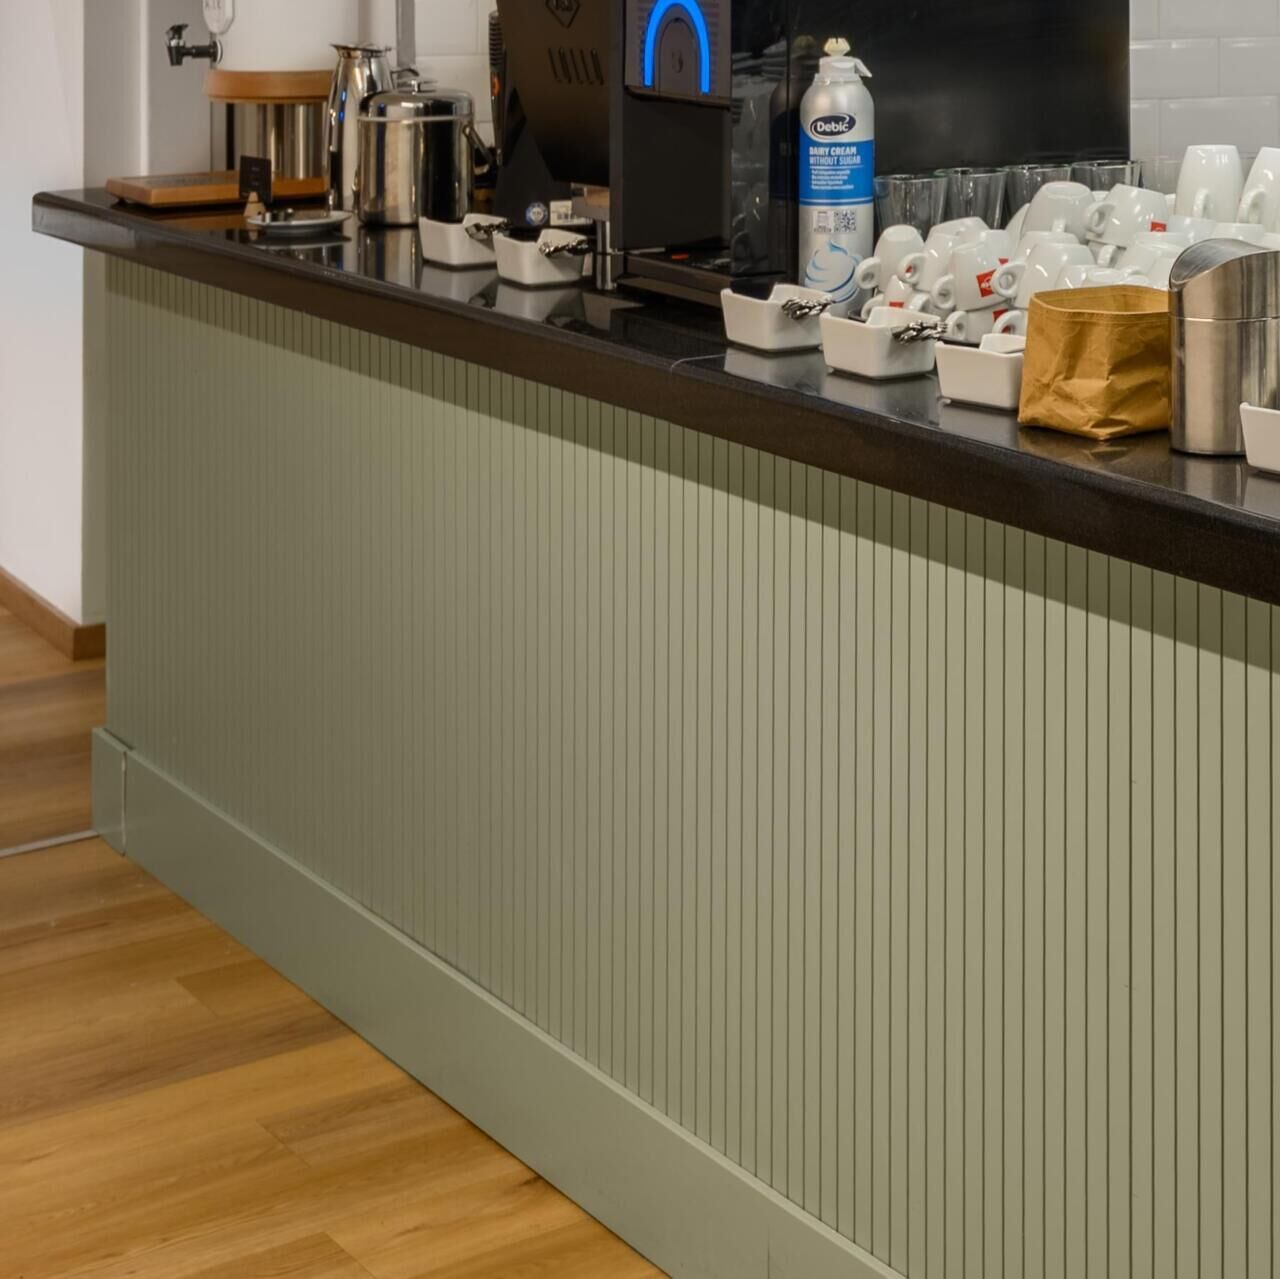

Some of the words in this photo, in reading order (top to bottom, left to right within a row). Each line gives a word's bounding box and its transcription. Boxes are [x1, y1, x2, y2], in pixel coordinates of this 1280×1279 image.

[816, 121, 849, 132] Debic
[831, 146, 857, 155] CREAM
[809, 155, 838, 166] WITHOUT
[839, 155, 861, 165] SUGAR
